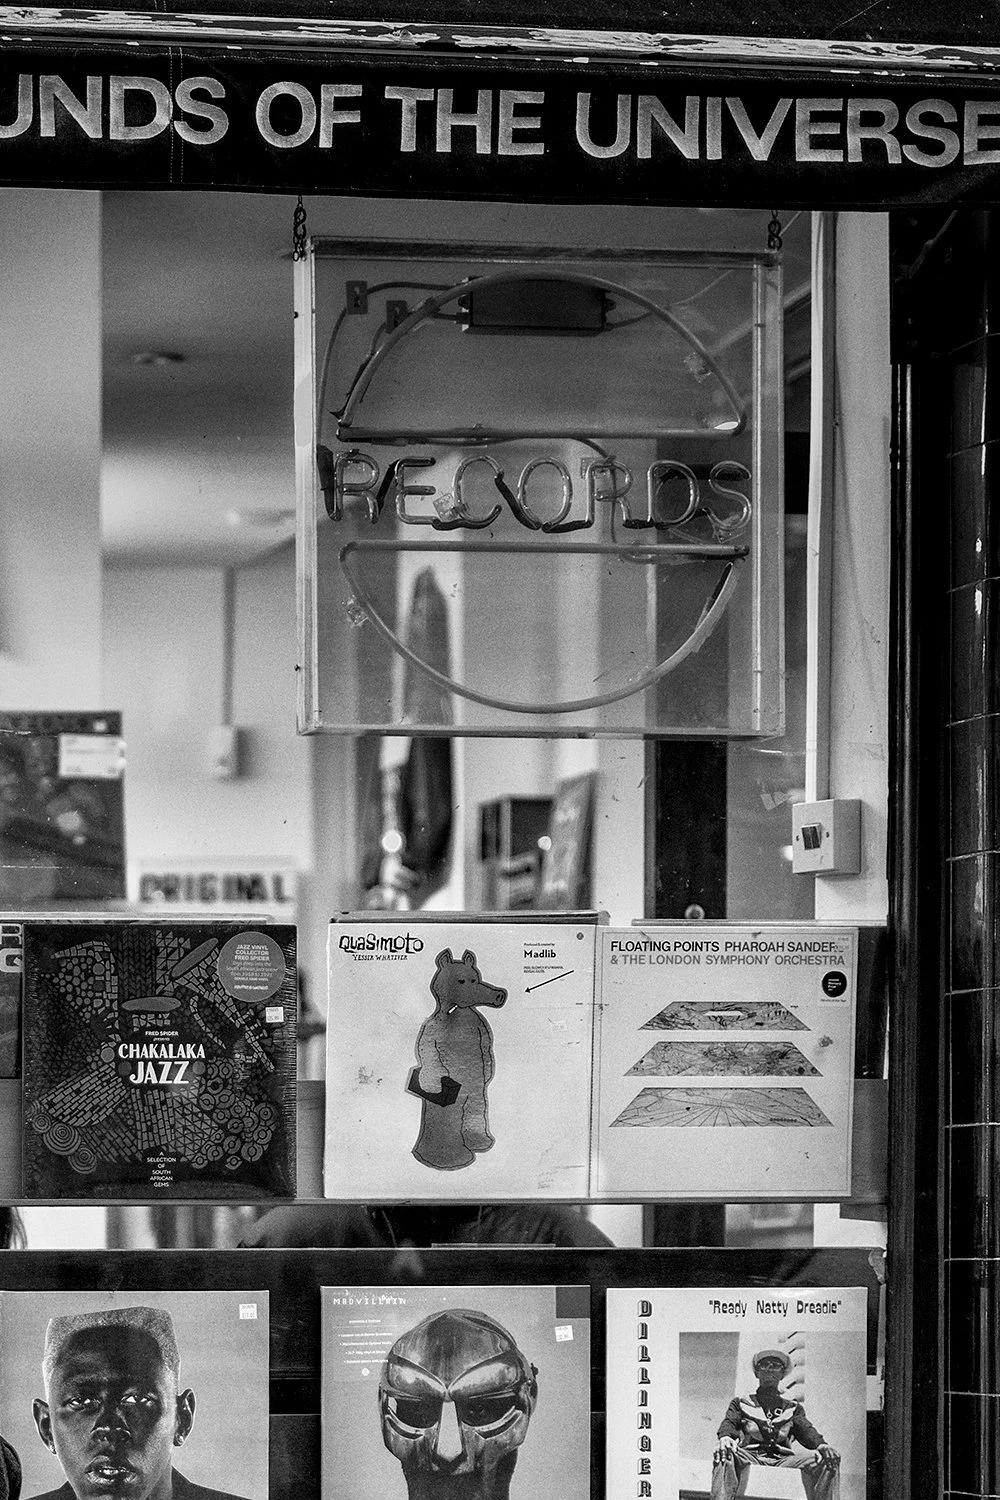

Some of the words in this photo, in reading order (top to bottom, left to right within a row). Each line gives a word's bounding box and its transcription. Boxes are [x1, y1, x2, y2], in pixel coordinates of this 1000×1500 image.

[255, 80, 364, 150] OF
[384, 85, 546, 156] THE
[575, 90, 1000, 168] UNIVERSE
[333, 449, 753, 531] RECORDS
[523, 949, 557, 959] Madlib
[610, 940, 671, 952] FLOATING
[673, 940, 720, 952] POINTS
[724, 941, 785, 953] PHAROAH
[787, 941, 845, 953] SANDER
[610, 954, 619, 965] &
[619, 954, 646, 965] THE
[649, 954, 701, 966] LONDON
[705, 954, 770, 966] SYMPHONY
[774, 955, 846, 966] ORCHESTRA
[117, 1042, 206, 1059] CHAKALAKA
[128, 1060, 190, 1085] JAZZ
[755, 1300, 790, 1318] Natty
[637, 1299, 653, 1499] DILLINGER
